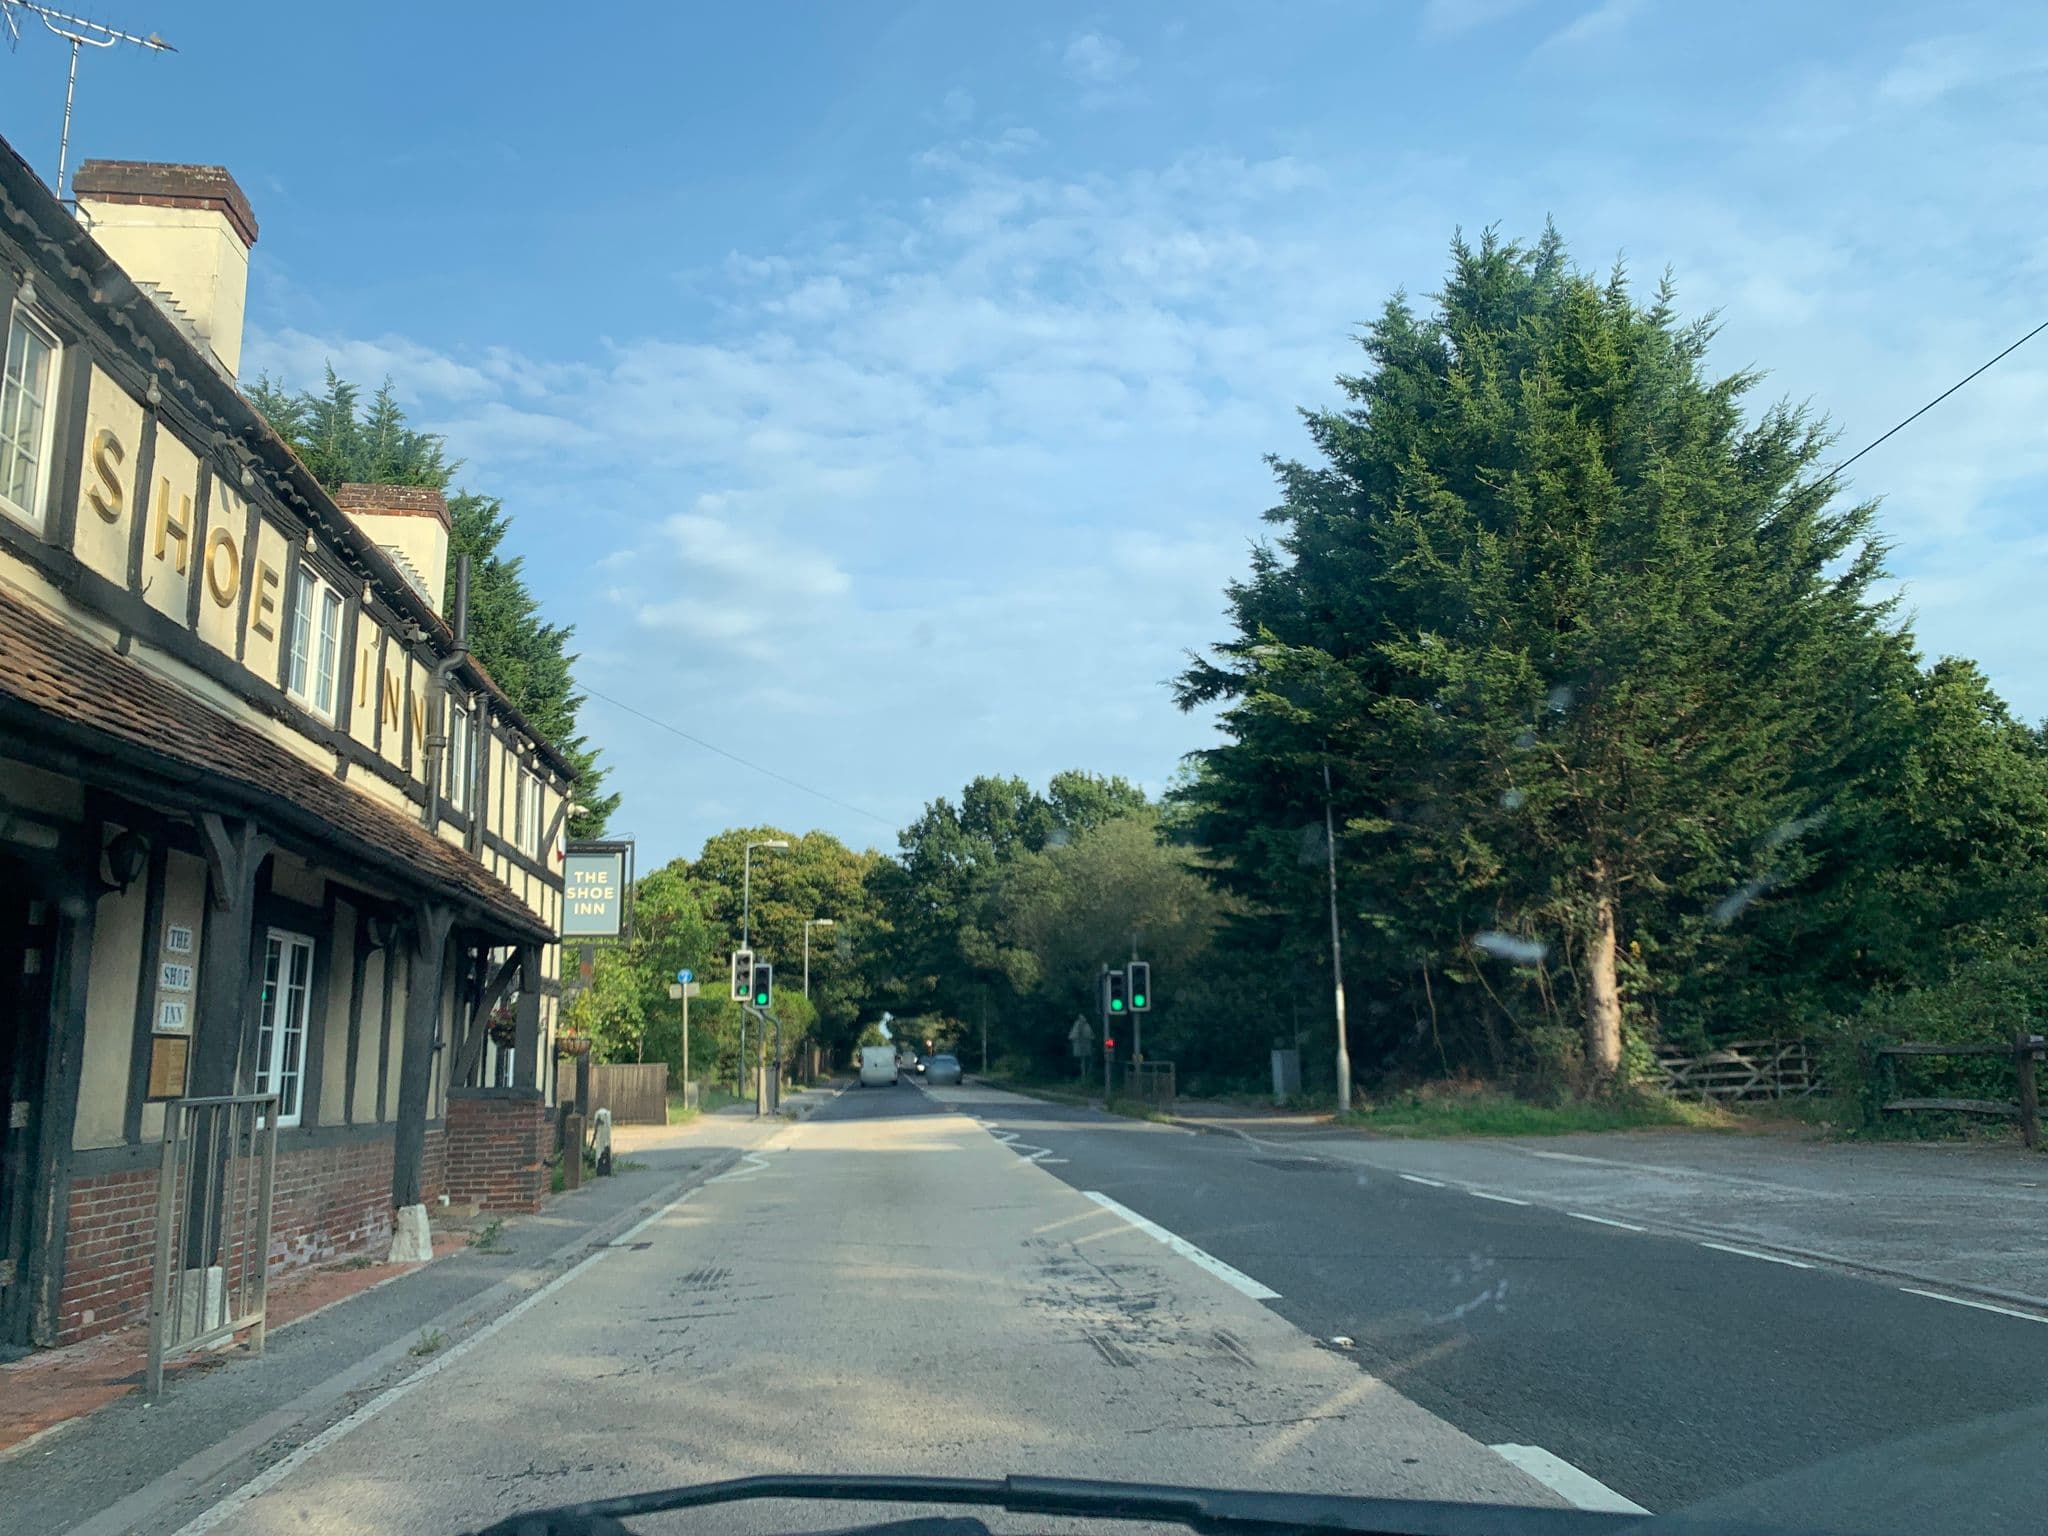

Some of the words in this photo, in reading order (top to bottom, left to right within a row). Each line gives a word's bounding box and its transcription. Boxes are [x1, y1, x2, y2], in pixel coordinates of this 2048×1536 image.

[88, 428, 280, 643] SHOE
[358, 648, 424, 750] INN
[574, 871, 608, 884] THE
[566, 887, 614, 899] SHOE
[574, 903, 605, 915] INN
[170, 929, 190, 949] THE
[164, 967, 190, 987] SHOE
[164, 1006, 183, 1024] INN
